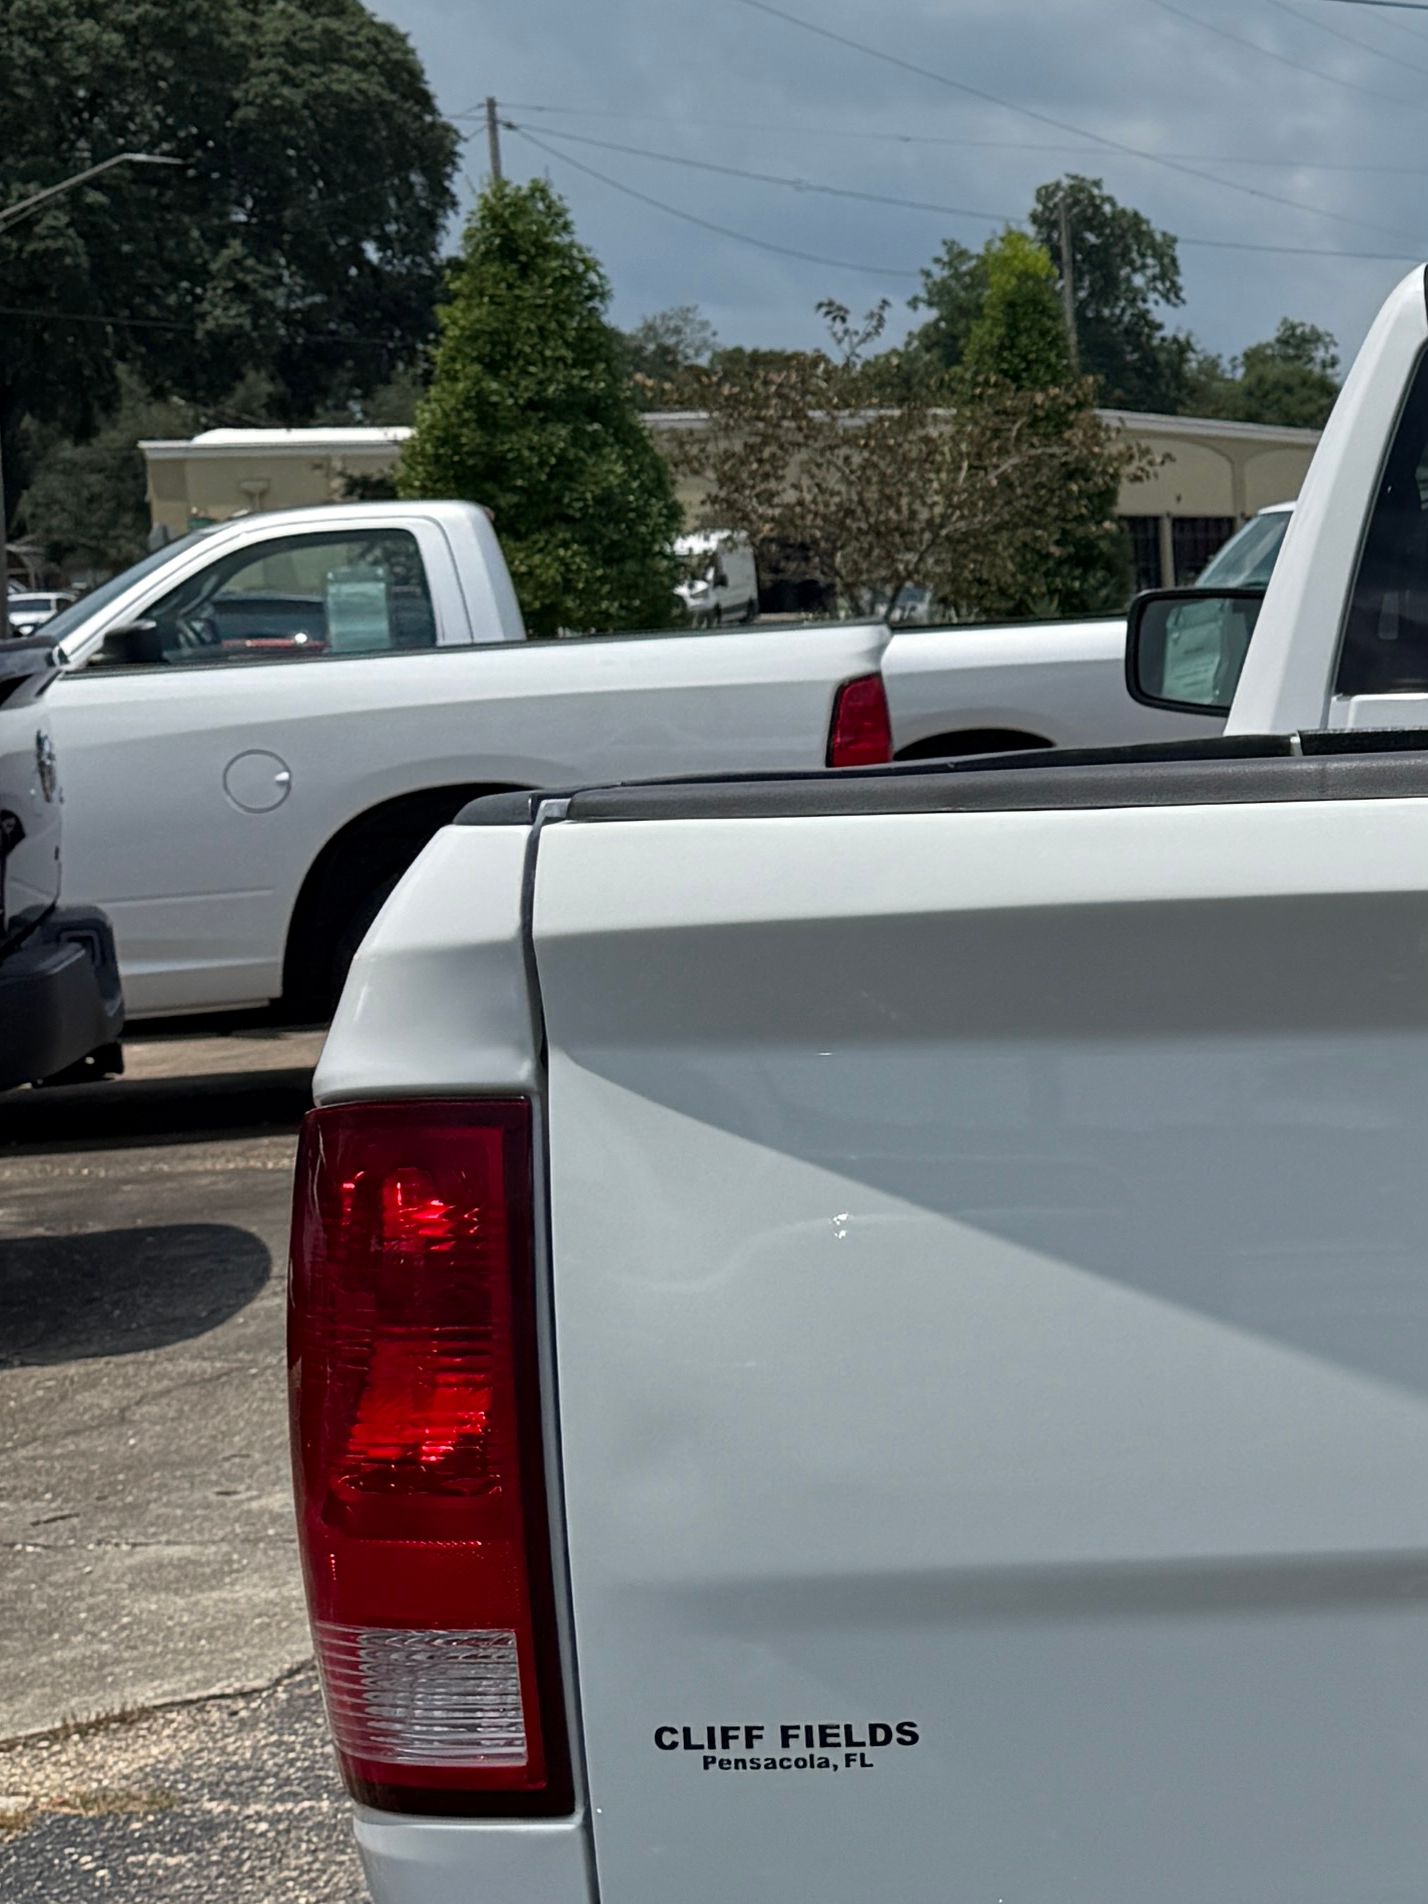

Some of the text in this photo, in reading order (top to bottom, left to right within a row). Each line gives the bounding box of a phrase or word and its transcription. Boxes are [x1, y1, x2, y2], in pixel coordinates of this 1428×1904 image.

[654, 1721, 920, 1750] CLIFF FIELDS
[702, 1752, 874, 1773] Pensacola, FL
